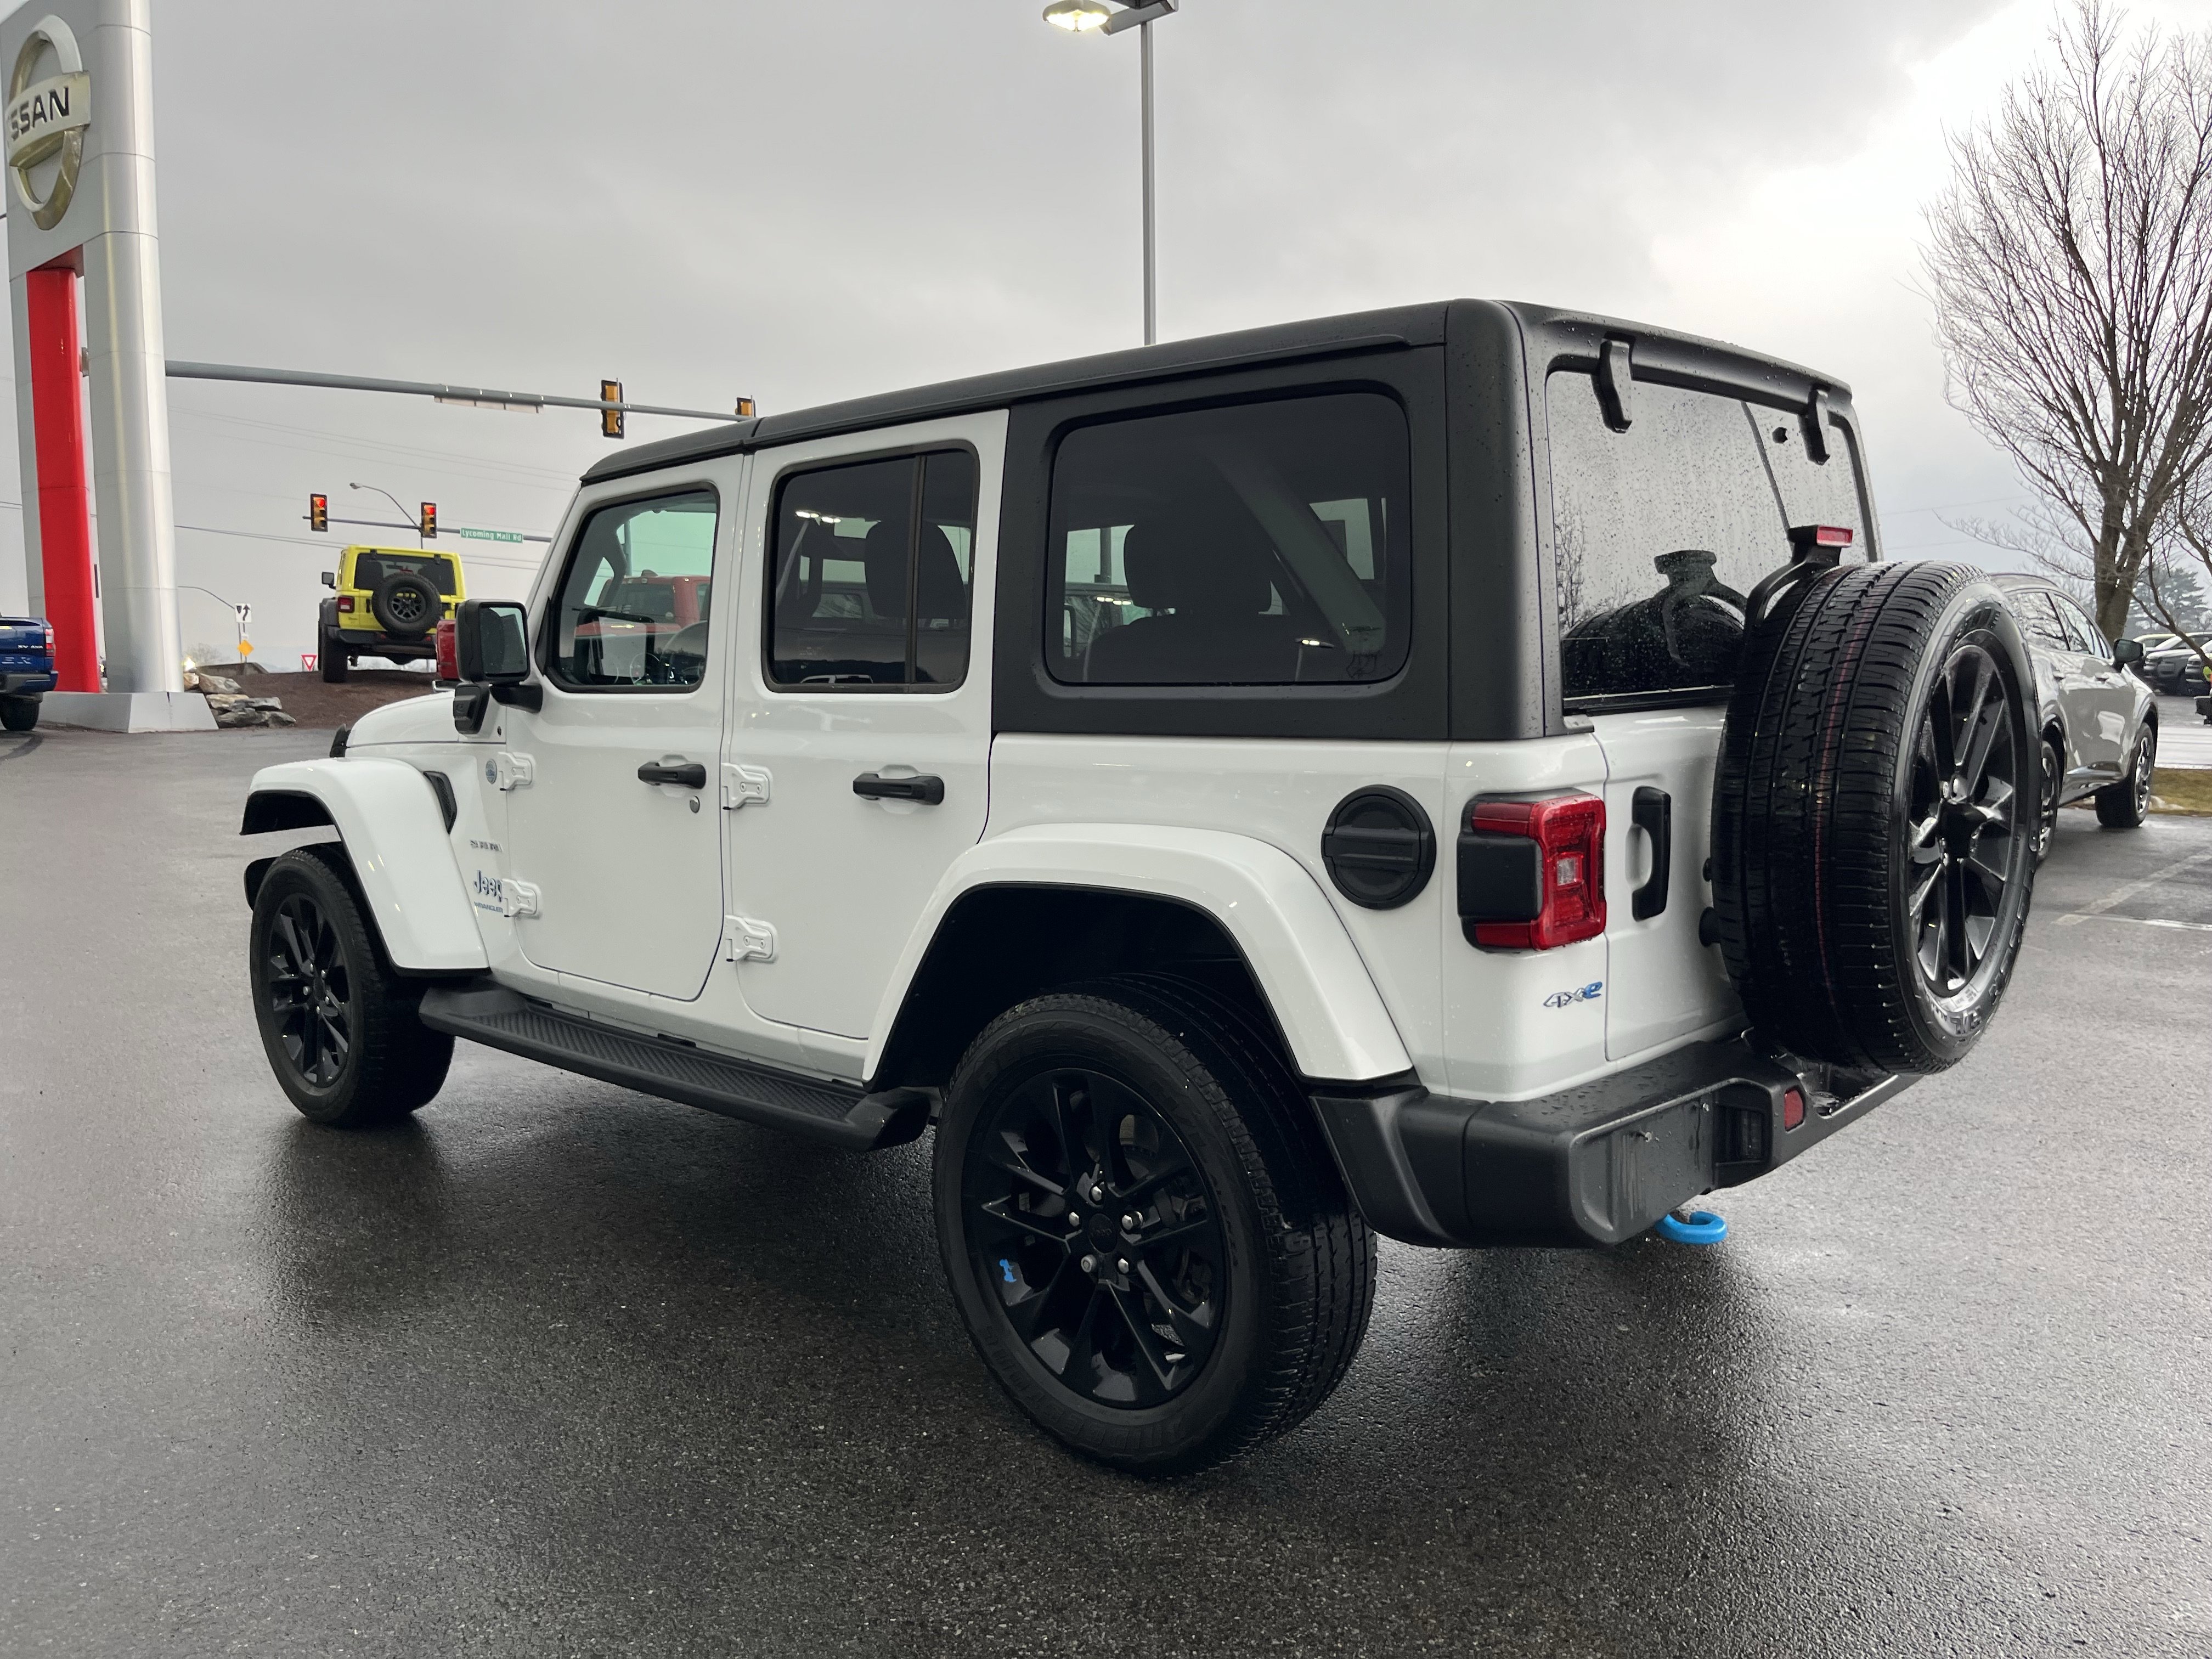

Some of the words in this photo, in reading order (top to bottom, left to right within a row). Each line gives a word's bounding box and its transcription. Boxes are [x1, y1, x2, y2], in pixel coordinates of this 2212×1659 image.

[10, 86, 70, 142] SSAN
[462, 529, 494, 540] Lycoming
[473, 870, 503, 902] Jeep
